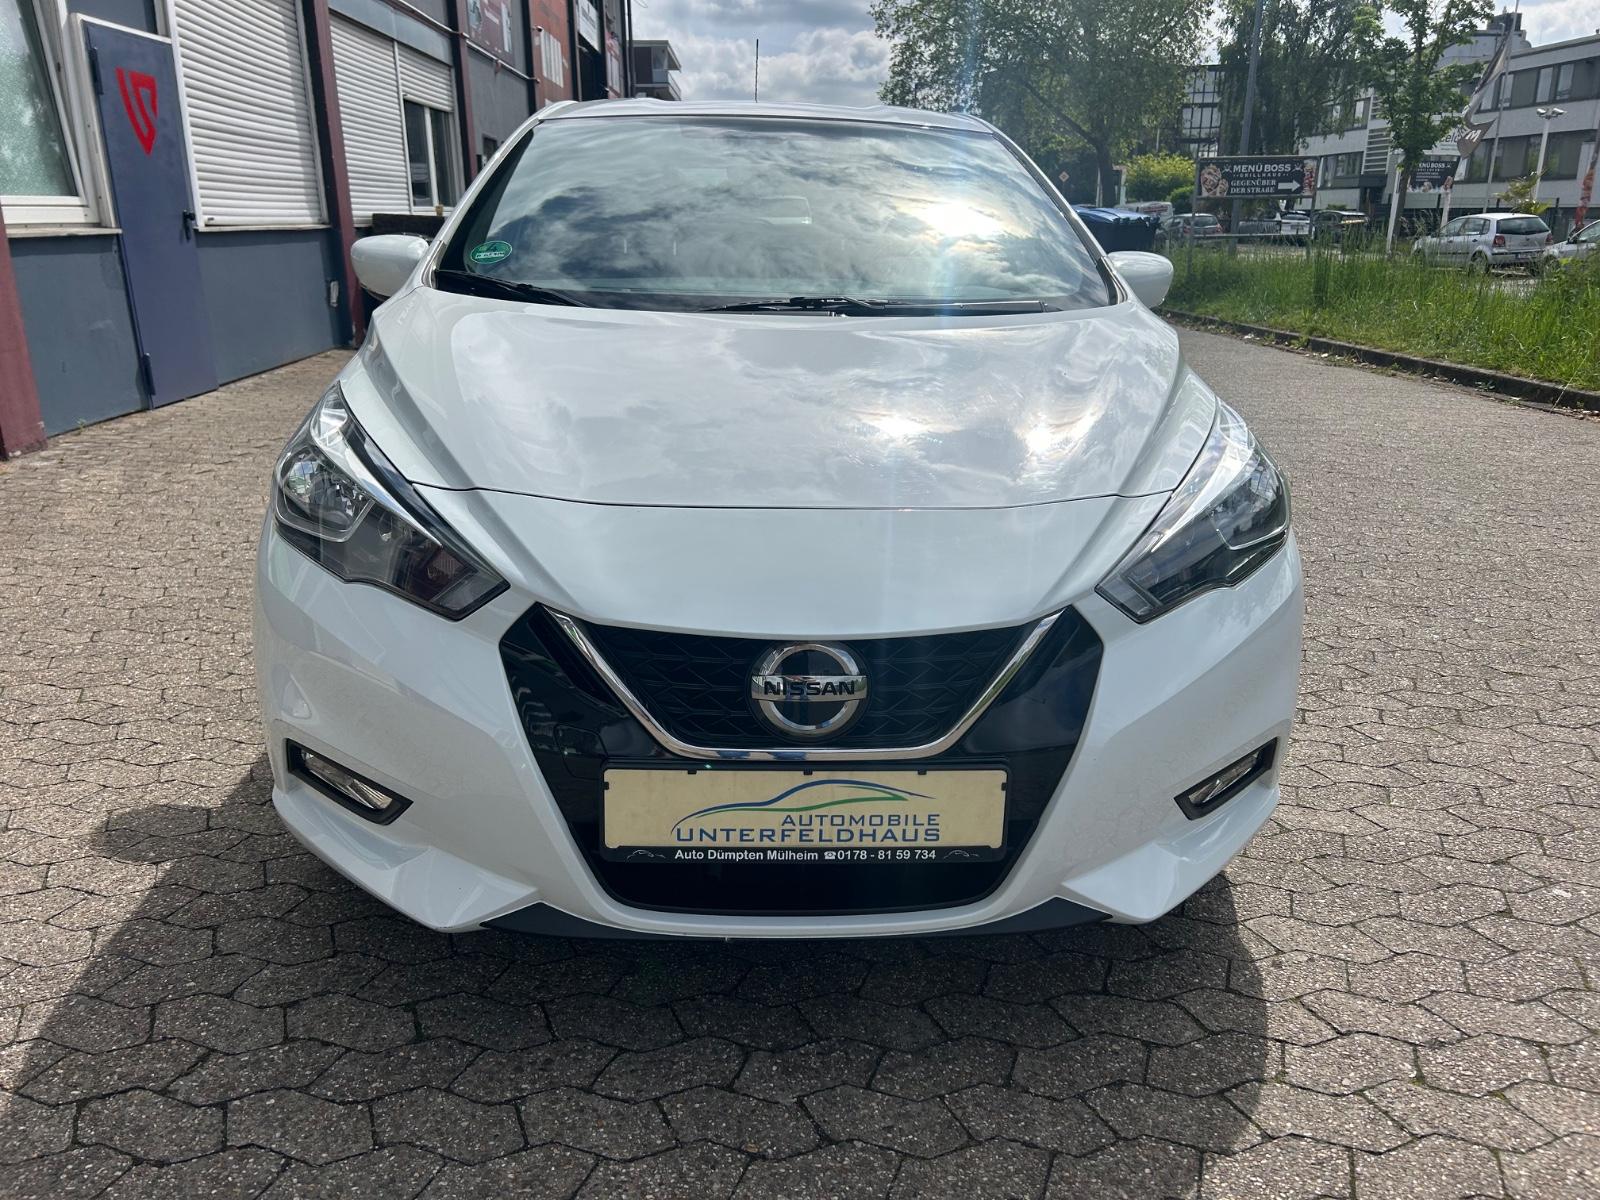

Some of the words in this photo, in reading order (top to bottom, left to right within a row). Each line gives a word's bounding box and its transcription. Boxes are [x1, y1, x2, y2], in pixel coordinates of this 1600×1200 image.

[1233, 163, 1262, 172] MENÜ
[1264, 164, 1291, 172] BOSS
[764, 680, 854, 696] NISSAN
[782, 814, 940, 826] AUTOMOBILE
[676, 828, 940, 842] UNTERFELDHAUS
[674, 850, 704, 859] Auto
[708, 850, 763, 862] Dümpten
[767, 850, 818, 860] Mülheim
[837, 850, 867, 860] 0178
[878, 850, 892, 859] 81
[896, 850, 911, 859] 59
[915, 850, 936, 859] 734
